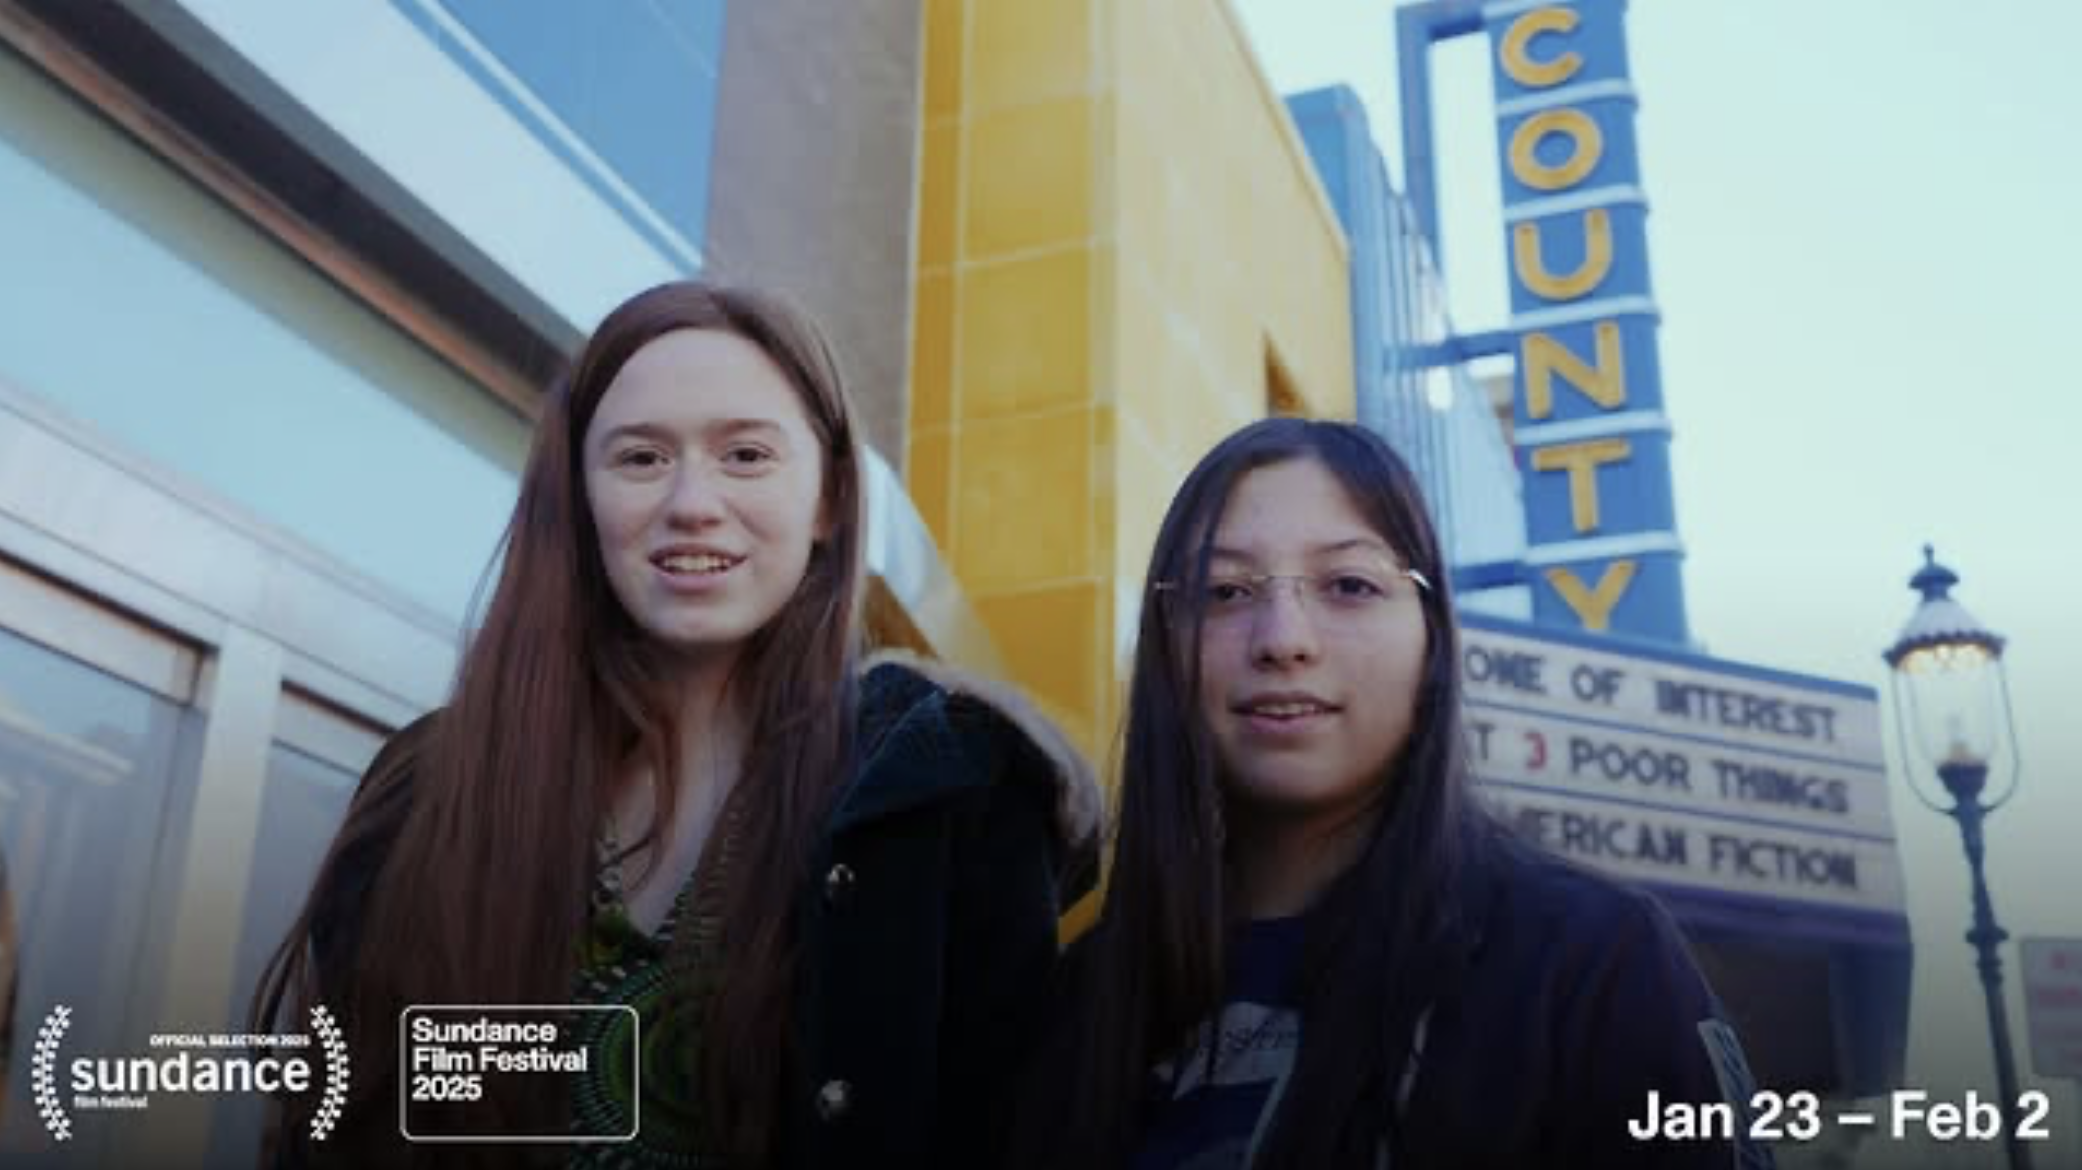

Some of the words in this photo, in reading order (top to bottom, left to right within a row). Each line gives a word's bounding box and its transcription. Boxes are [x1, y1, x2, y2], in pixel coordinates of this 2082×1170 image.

[1500, 6, 1638, 632] COUNTY
[1569, 663, 1626, 706] OF
[1655, 679, 1837, 744] INTEREST
[1568, 736, 1693, 793] POOR
[1711, 758, 1850, 815] THINGS
[1708, 834, 1858, 890] FICTION
